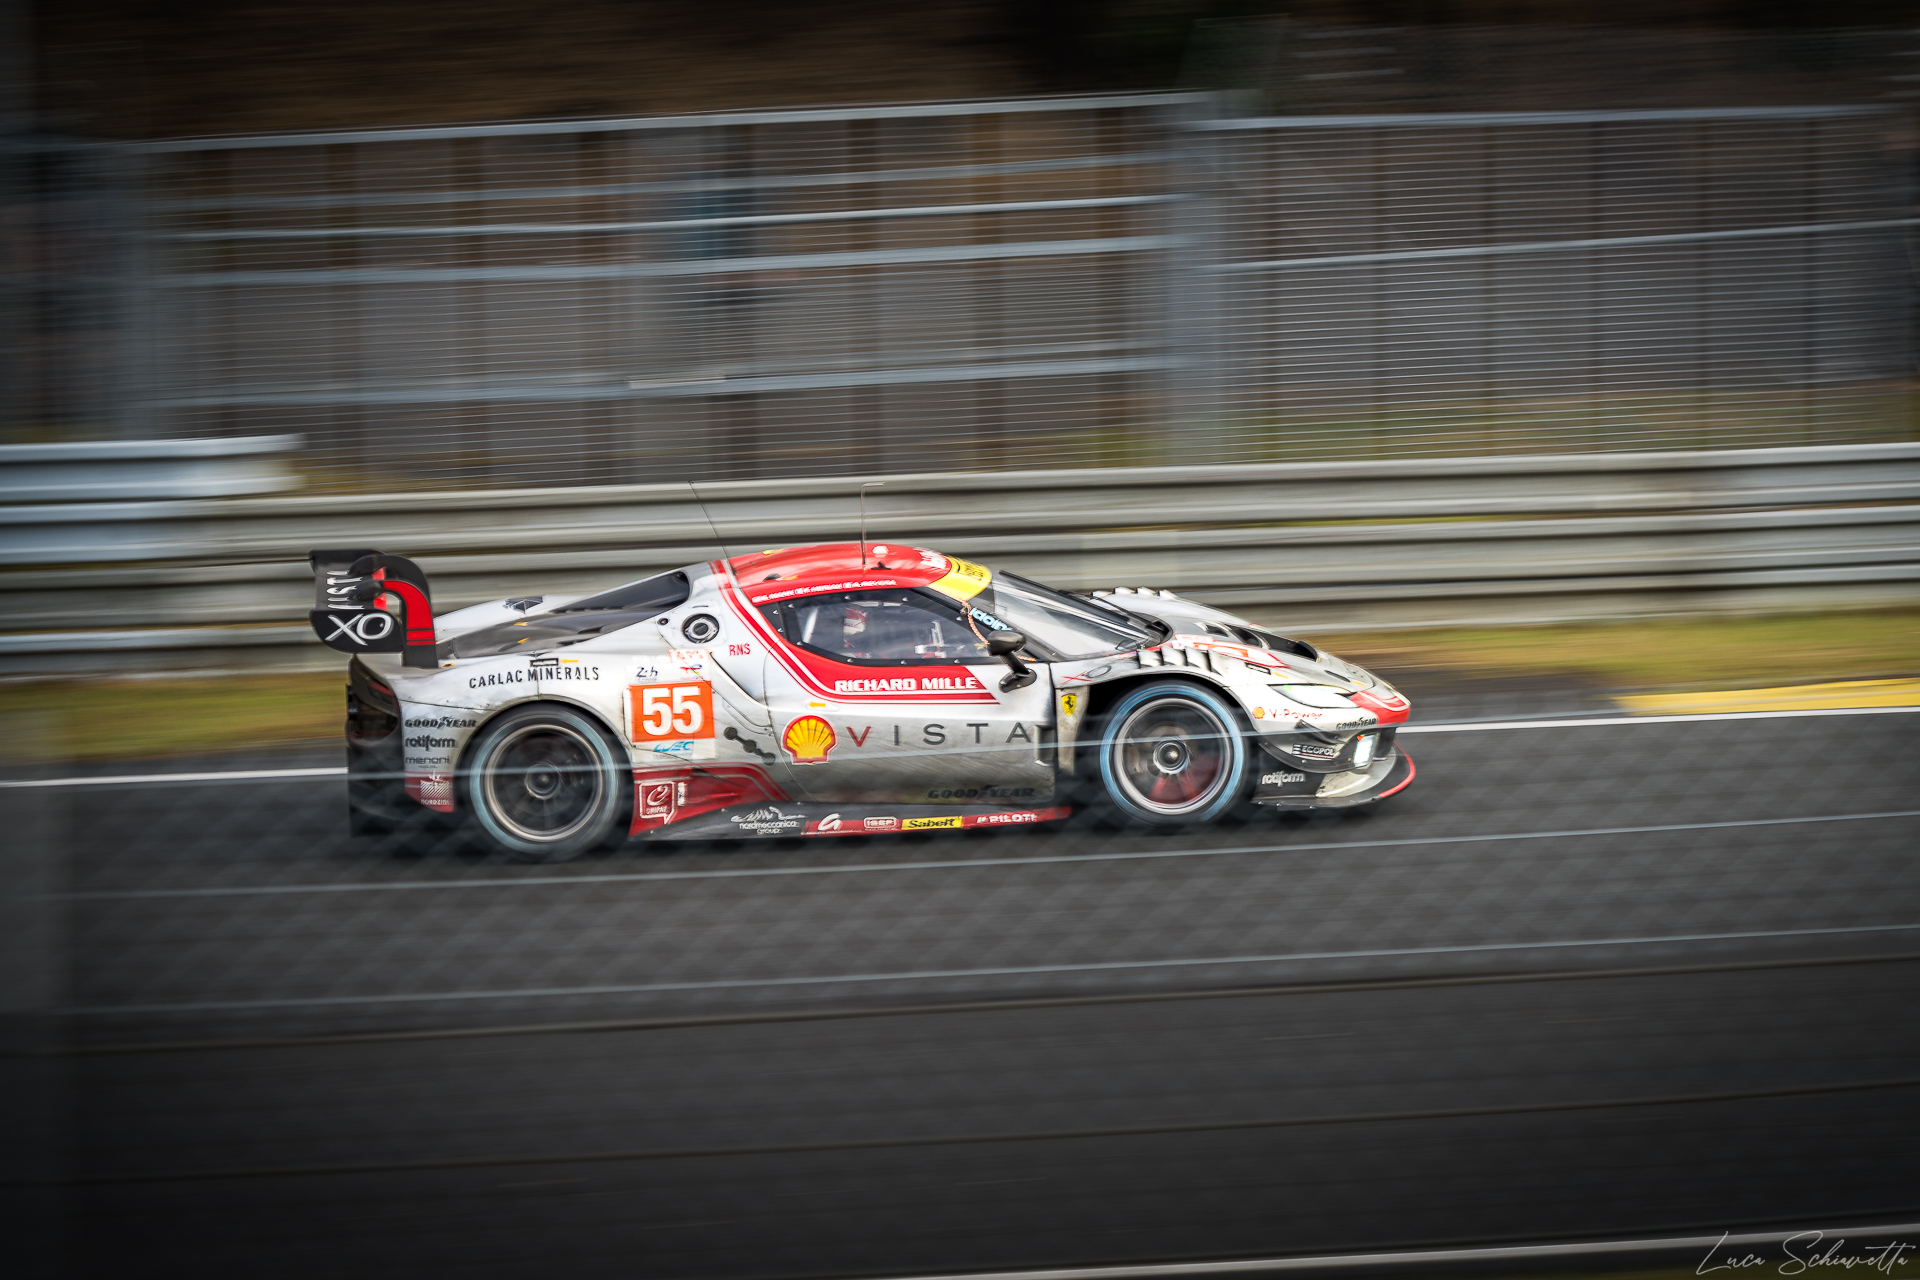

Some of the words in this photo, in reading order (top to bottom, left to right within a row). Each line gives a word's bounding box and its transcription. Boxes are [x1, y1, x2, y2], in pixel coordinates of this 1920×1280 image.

[325, 612, 394, 646] XO
[729, 644, 751, 656] RNS
[469, 669, 523, 689] CARLAC
[527, 666, 600, 682] MINERALS
[834, 678, 917, 692] RICHARD
[921, 676, 978, 691] MILLE
[642, 686, 704, 736] 55
[404, 716, 477, 730] GOODYEAR
[404, 734, 456, 752] rotiform
[846, 722, 1032, 748] VISTA
[1261, 770, 1305, 787] rotiform
[928, 785, 1036, 800] GOODYEAR
